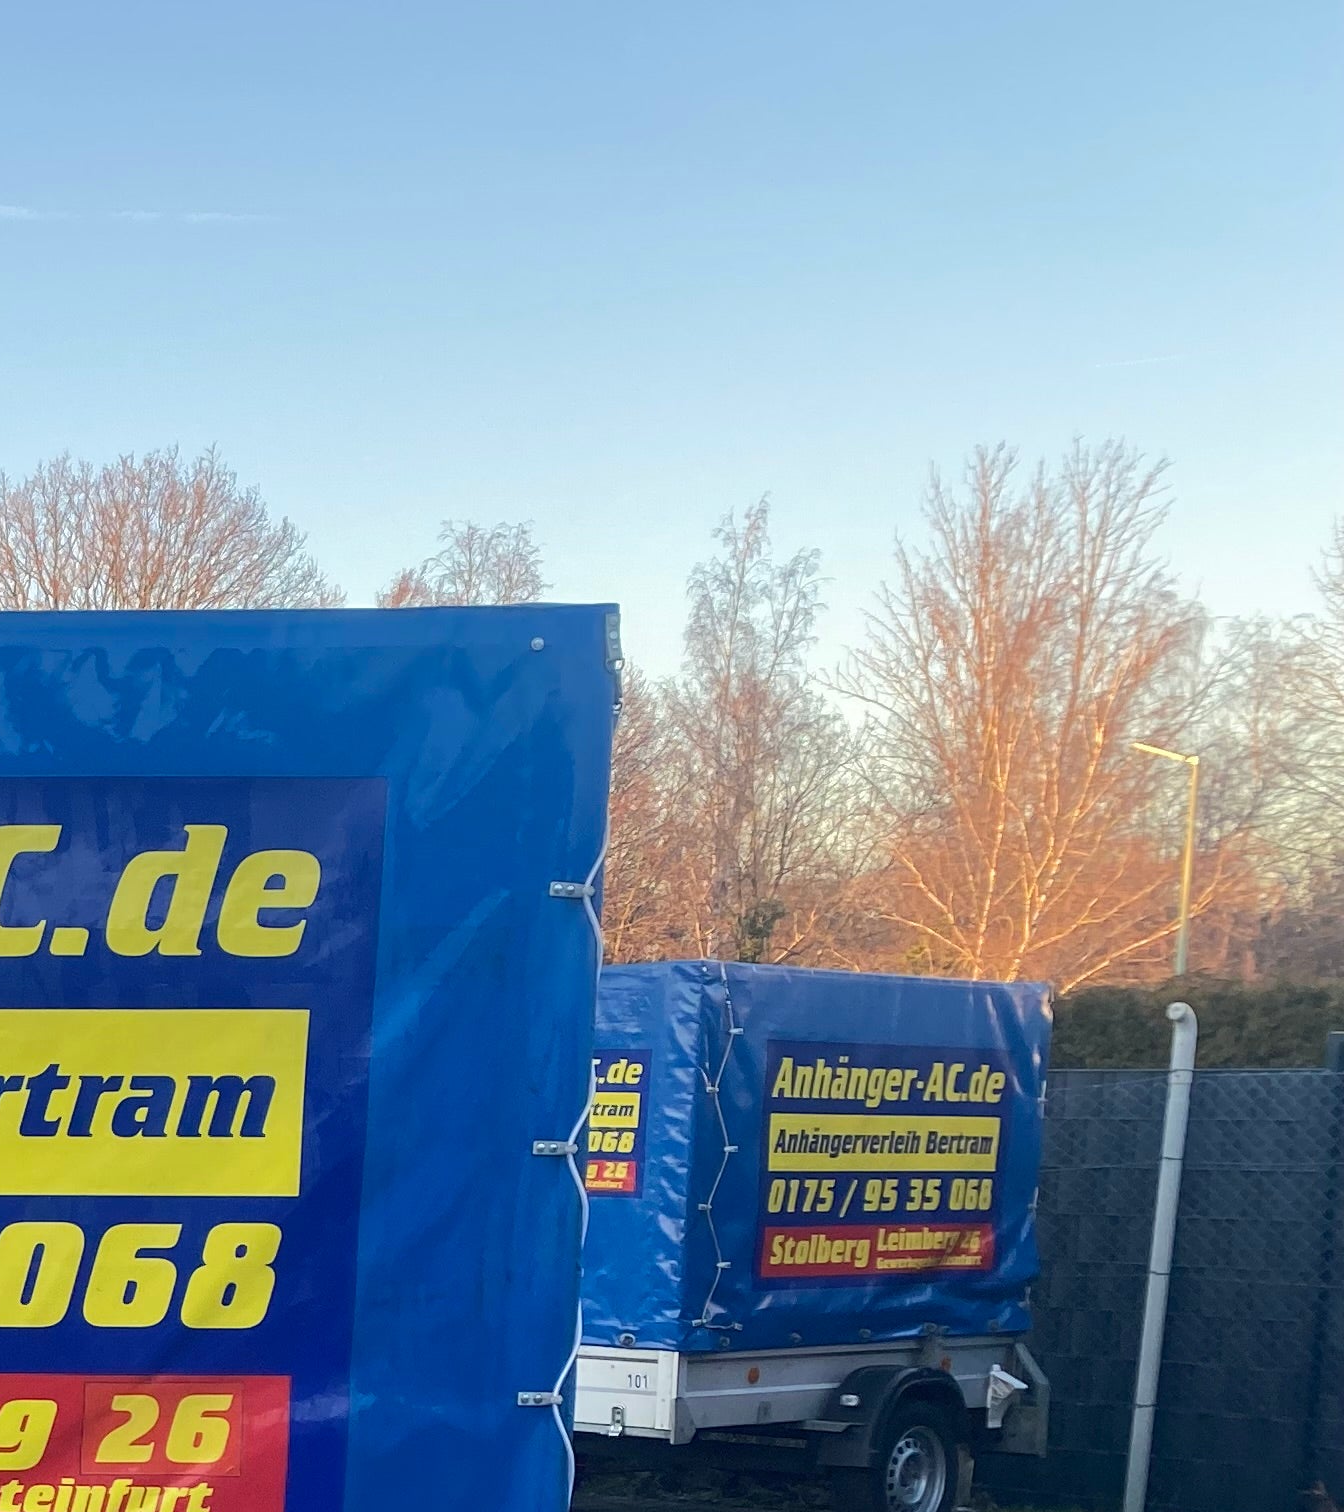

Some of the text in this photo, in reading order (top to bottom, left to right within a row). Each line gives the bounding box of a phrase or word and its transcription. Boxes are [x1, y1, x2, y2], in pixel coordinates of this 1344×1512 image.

[771, 1055, 1006, 1109] Anhänger-AC.de
[773, 1127, 994, 1159] Anhängerverleih Bertram
[767, 1178, 993, 1218] 0175 / 95 35 068
[769, 1234, 870, 1268] Stolberg
[628, 1374, 648, 1389] 101
[95, 1394, 234, 1465] 26
